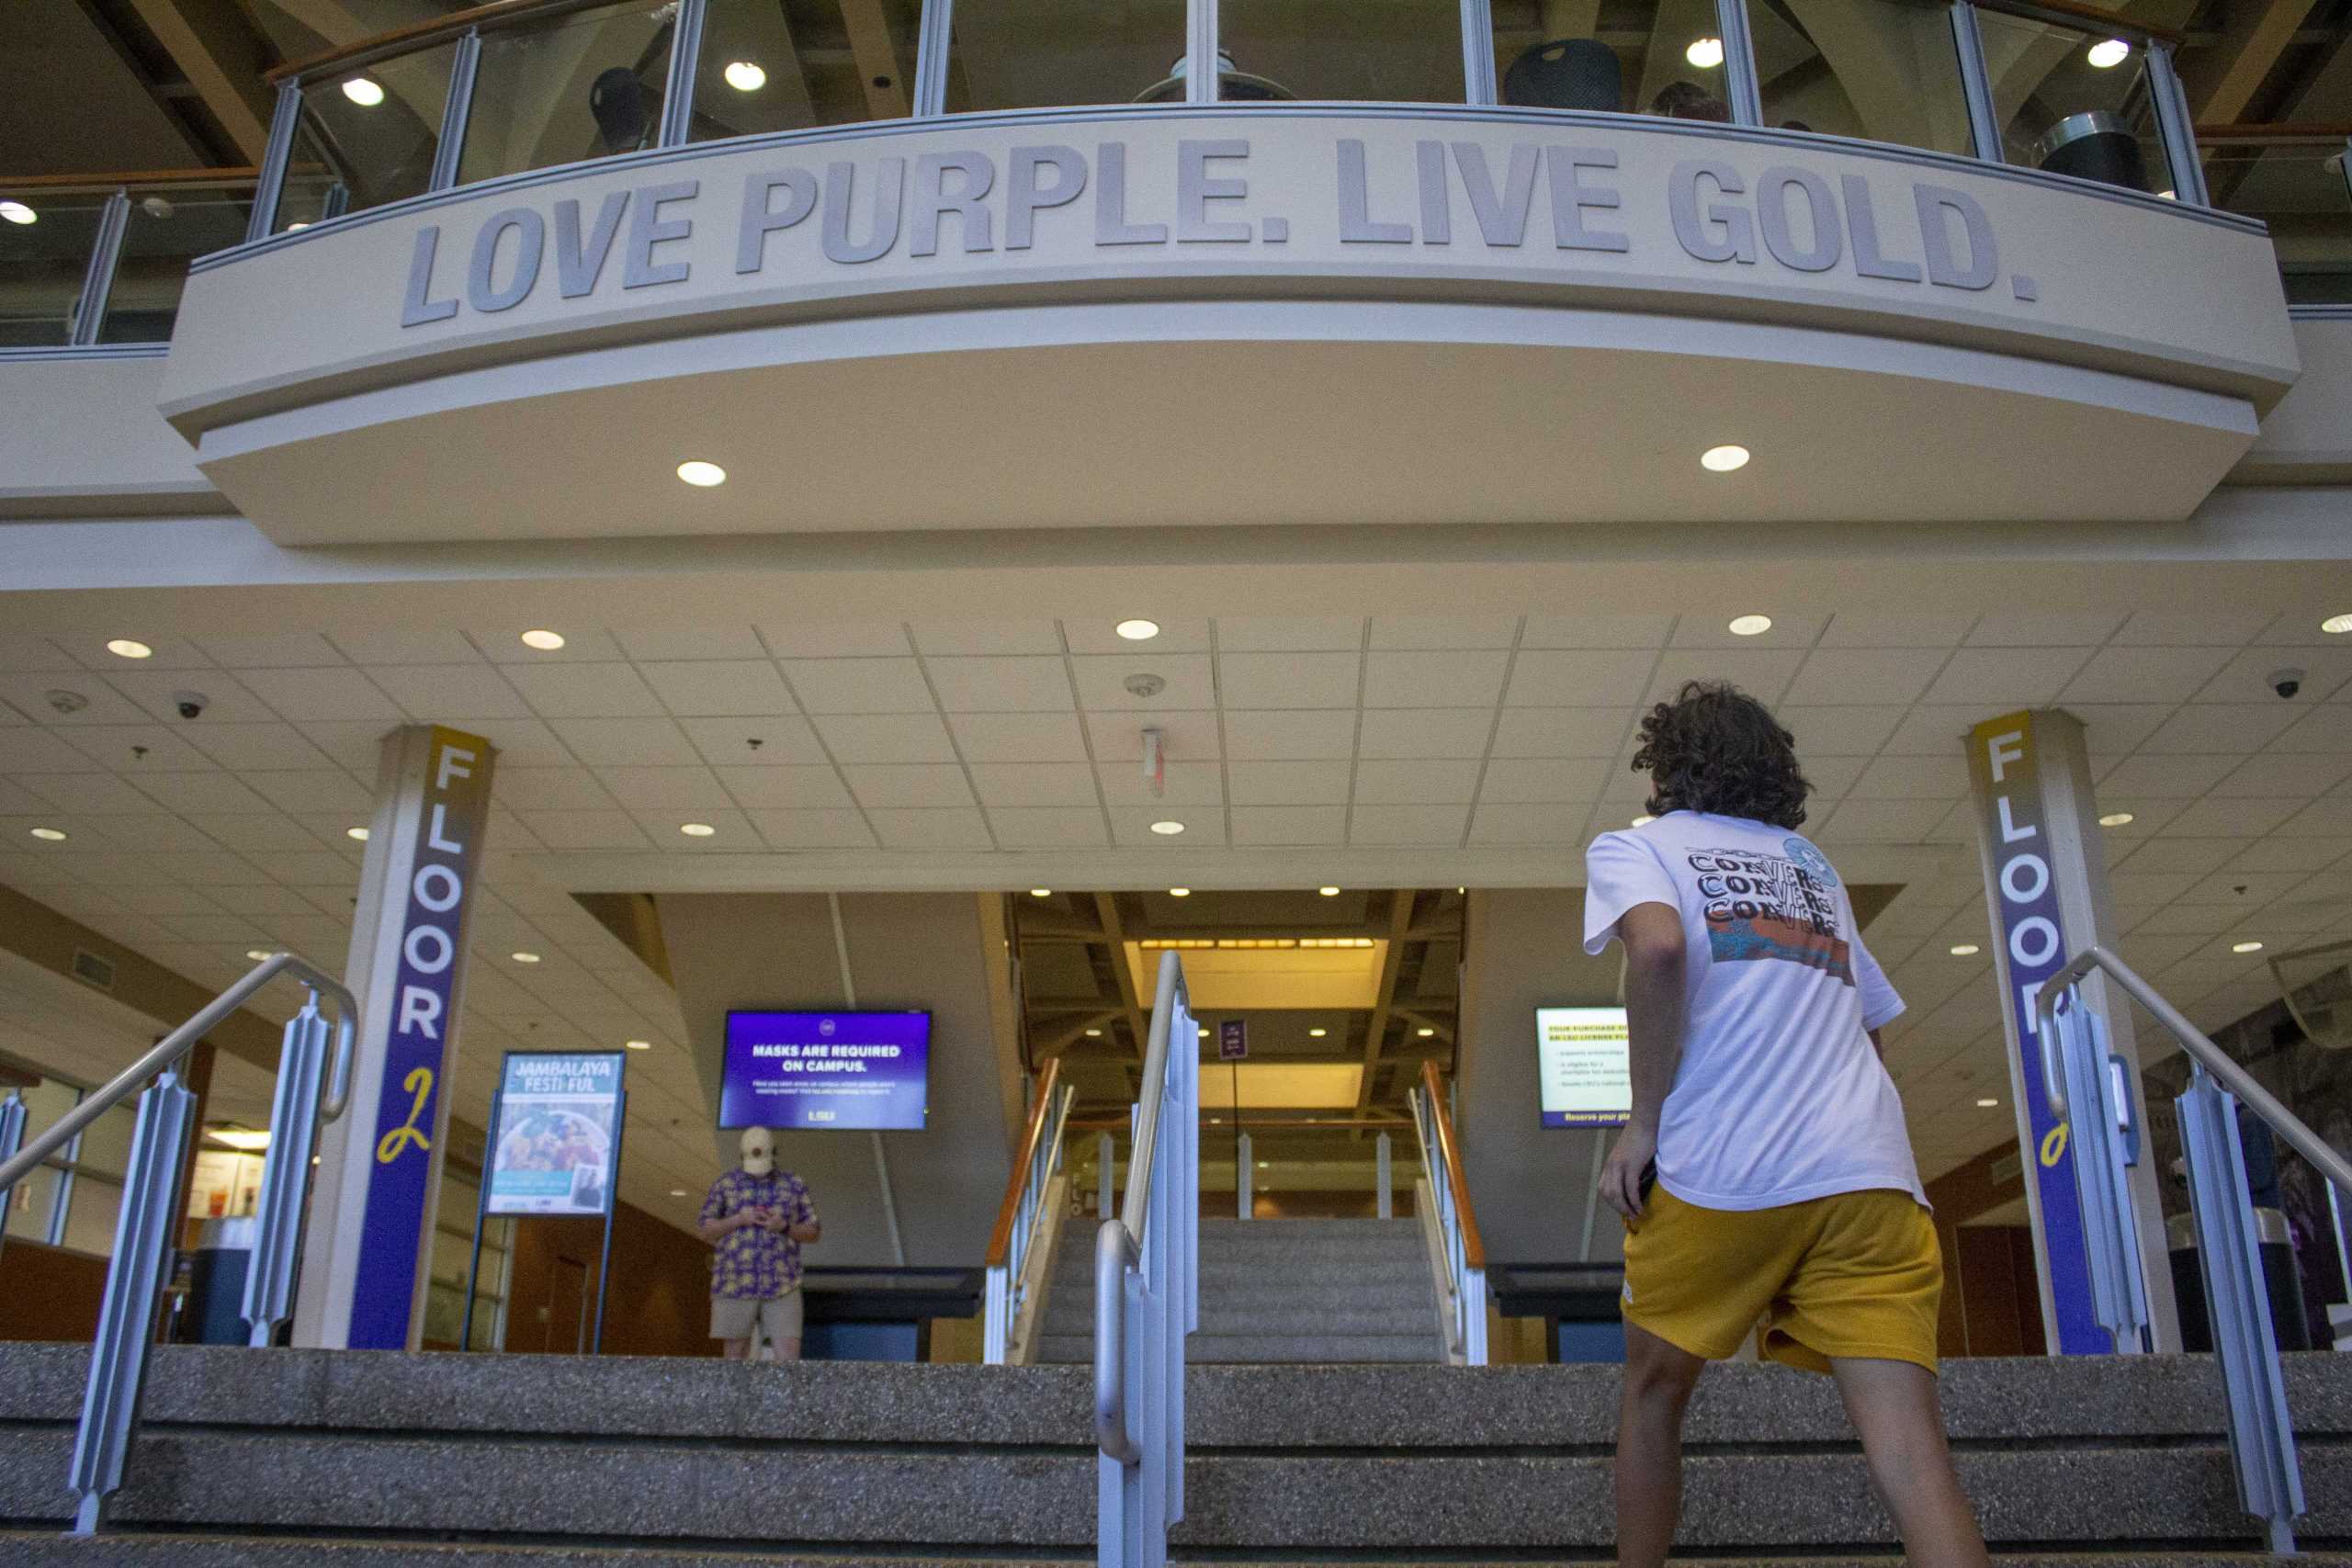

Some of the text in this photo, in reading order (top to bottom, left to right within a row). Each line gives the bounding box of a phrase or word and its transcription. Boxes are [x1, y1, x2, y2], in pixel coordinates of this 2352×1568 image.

[401, 139, 2037, 328] LOVE PURPLE. LIVE GOLD.
[398, 745, 475, 1039] FLOOR
[752, 1044, 900, 1057] MASKS ARE REQUIRED
[514, 1061, 611, 1077] JAMBALAYA
[783, 1060, 866, 1073] ON CAMPUS.
[378, 1067, 433, 1164] 2
[1599, 1114, 1618, 1122] your
